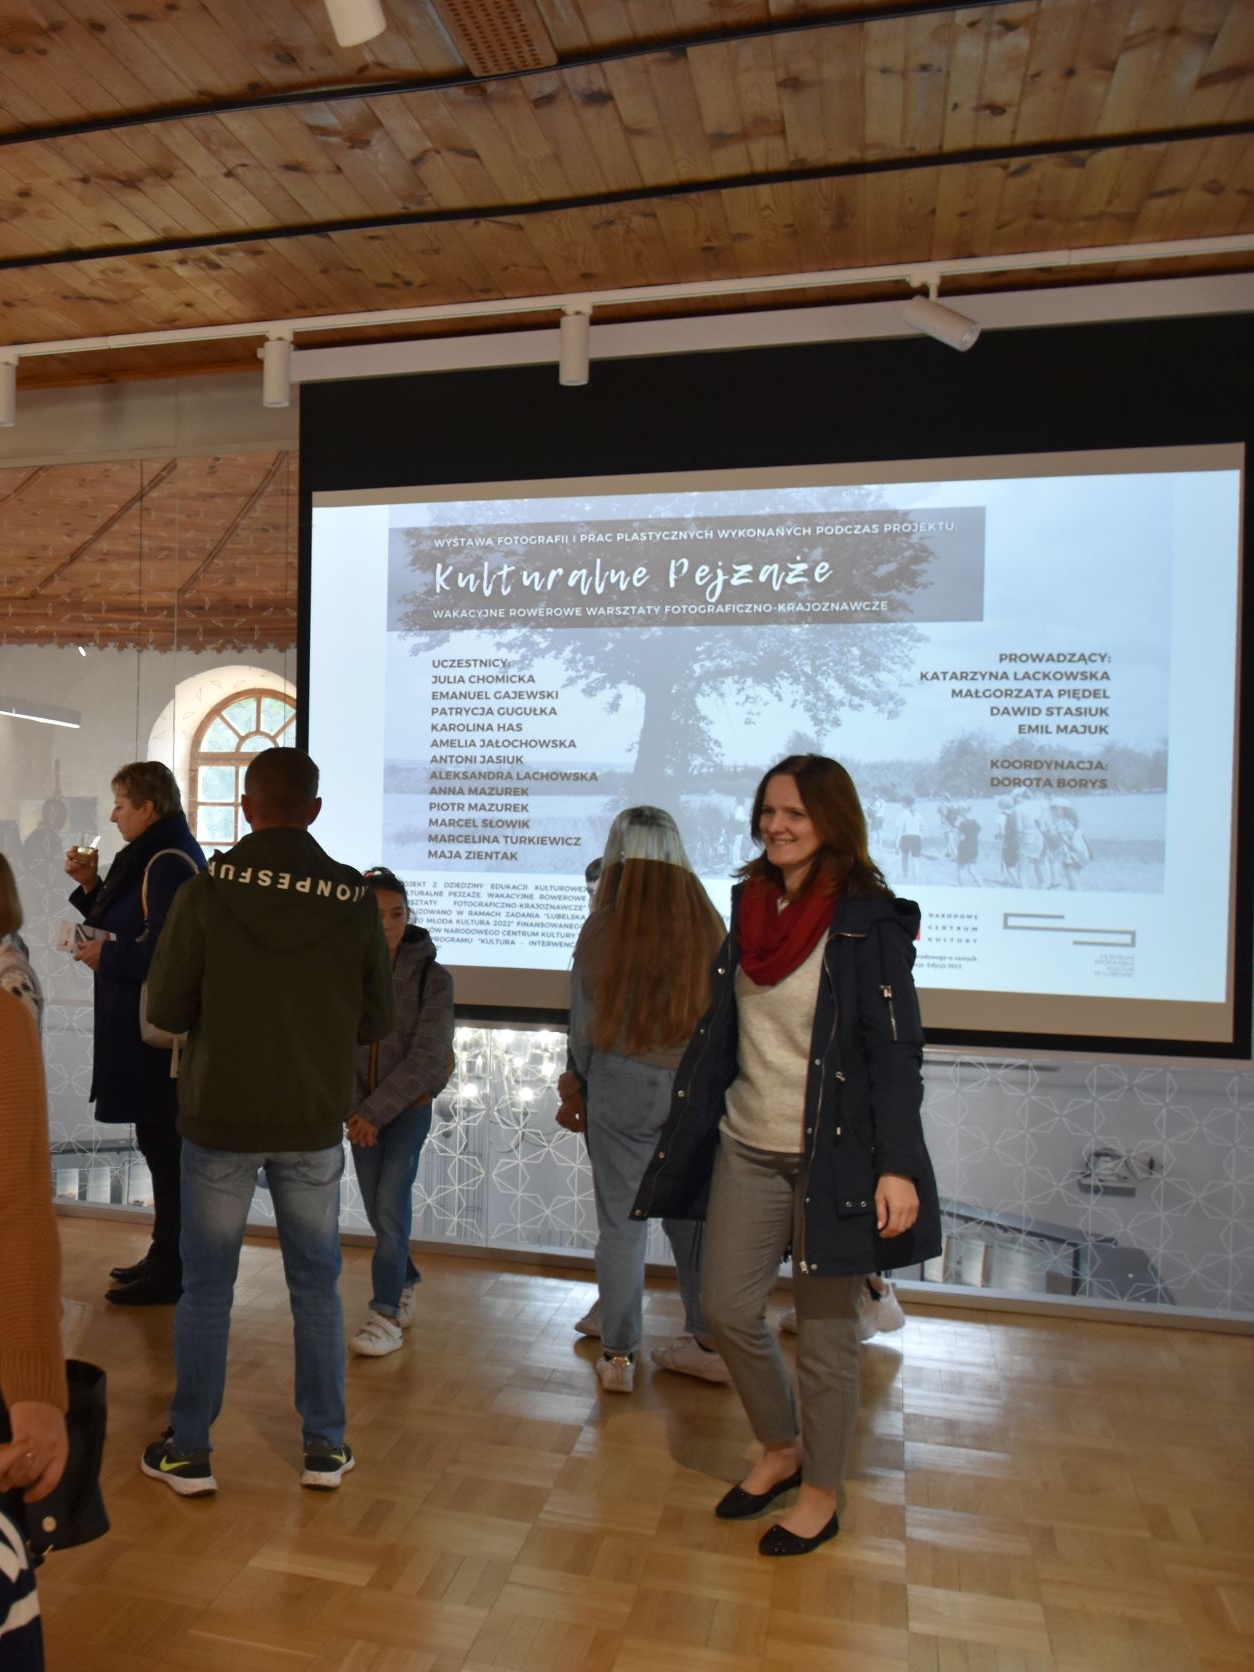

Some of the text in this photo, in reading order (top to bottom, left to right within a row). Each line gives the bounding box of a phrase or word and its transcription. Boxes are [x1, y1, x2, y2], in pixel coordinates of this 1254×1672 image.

[434, 537, 494, 547] WYSTAWA
[497, 535, 568, 545] FOTOGRAFII
[572, 535, 575, 543] I
[580, 533, 613, 543] PRAC
[617, 530, 713, 543] PLASTYCZNYCH
[718, 526, 811, 538] WYKONANYCH
[816, 523, 879, 535] PODCZAS
[434, 558, 650, 597] Kulturalne
[433, 601, 888, 619] WAKACYJNE ROWEROWE WARSZTATY FOTOGRAFICZNO-KRAJOZNAWCZE
[432, 658, 510, 668] UCZESTNICY:
[999, 652, 1111, 665] PROWADZĄCY:
[432, 674, 535, 684] JULIA CHOMICKA
[919, 671, 1110, 681] KATARZYNA LACKOWSKA
[432, 690, 558, 700] EMANUEL GAJEWSKI
[951, 689, 1110, 701] MAŁGORZATA PIĘDEL
[431, 706, 557, 716] PATRYCJA GUGUŁKA
[990, 706, 1109, 717] DAWID STASIUK
[430, 722, 522, 732] KAROLINA HAS
[1018, 724, 1109, 735] EMIL MAJUK
[430, 739, 577, 749] AMELIA JAŁOCHOWSKA
[430, 755, 524, 764] ANTONI JASIUK
[990, 759, 1108, 771] KOORDYNACJA:
[430, 770, 598, 782] ALEKSANDRA LACHOWSKA
[990, 777, 1108, 789] DOROTA BORYS
[429, 786, 529, 796] ANNA MAZUREK
[429, 802, 529, 812] PIOTR MAZUREK
[428, 818, 530, 829] MARCEL SŁOWIK
[428, 834, 581, 846] MARCELINA TURKIEWICZ
[428, 850, 518, 861] MAJA ZIENTAK
